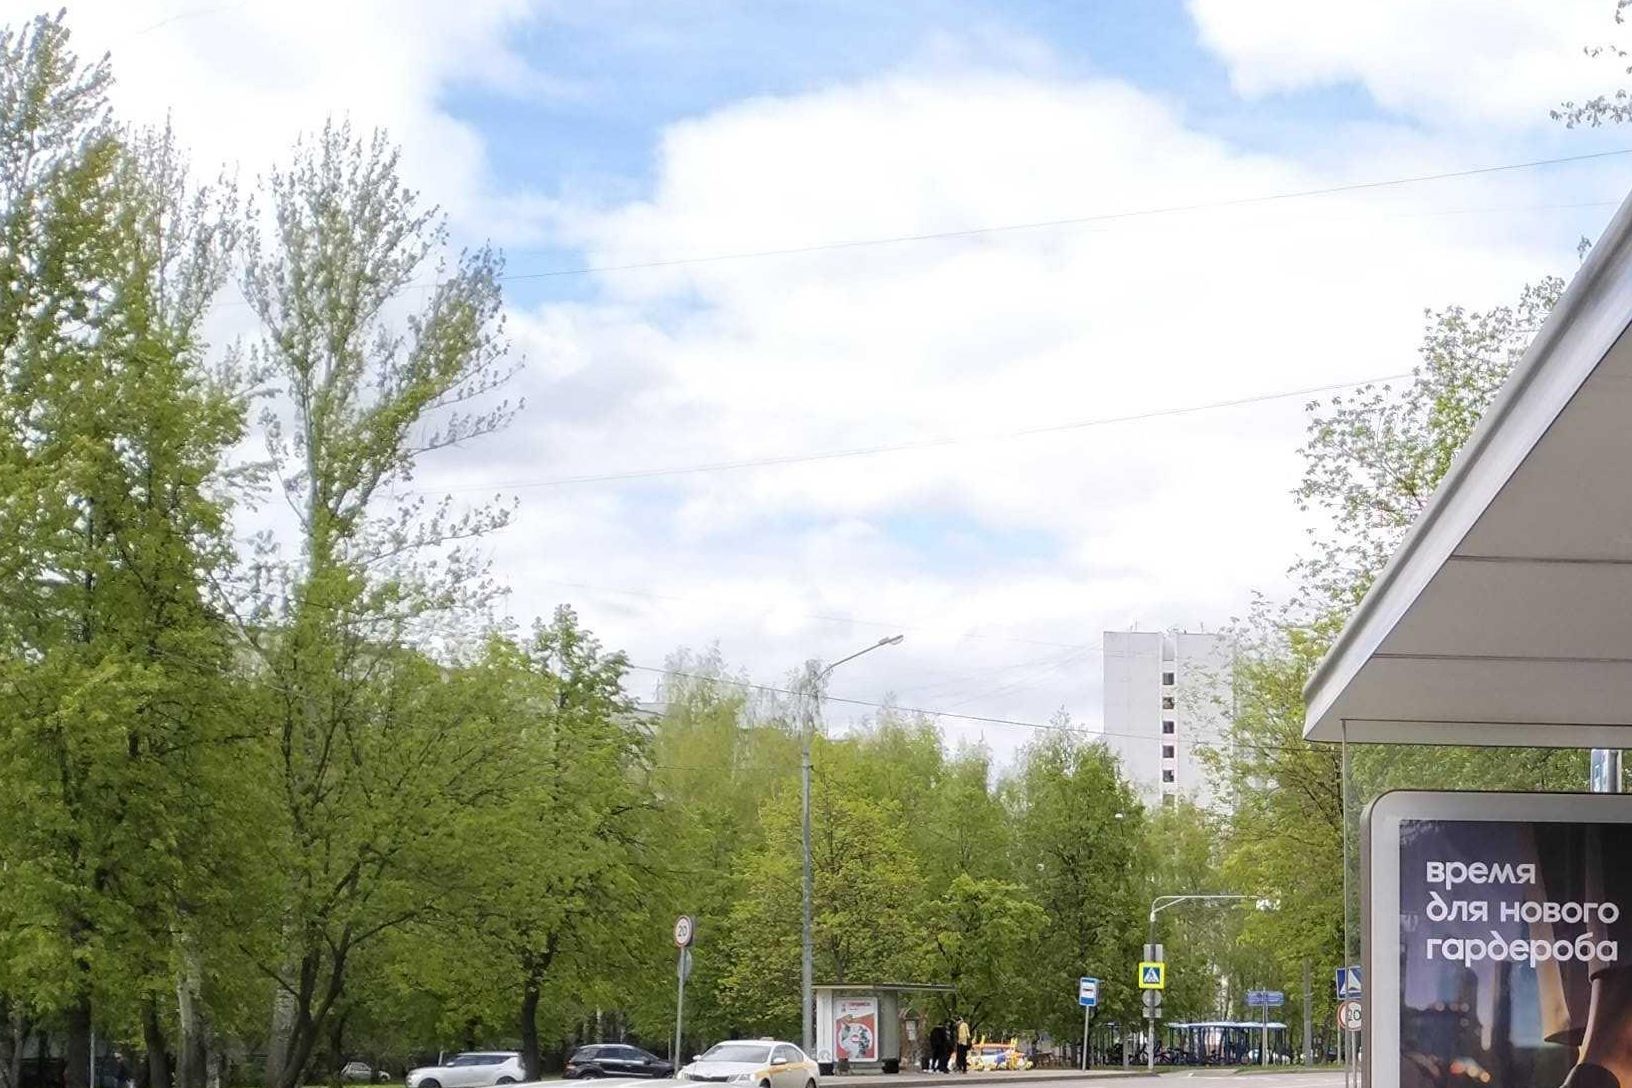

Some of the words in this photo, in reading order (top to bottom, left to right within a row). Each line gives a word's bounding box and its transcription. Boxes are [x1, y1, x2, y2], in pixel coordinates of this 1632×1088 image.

[1426, 861, 1536, 891] время
[1426, 891, 1488, 922] для
[1500, 901, 1620, 924] нового
[1426, 931, 1618, 969] гардероба
